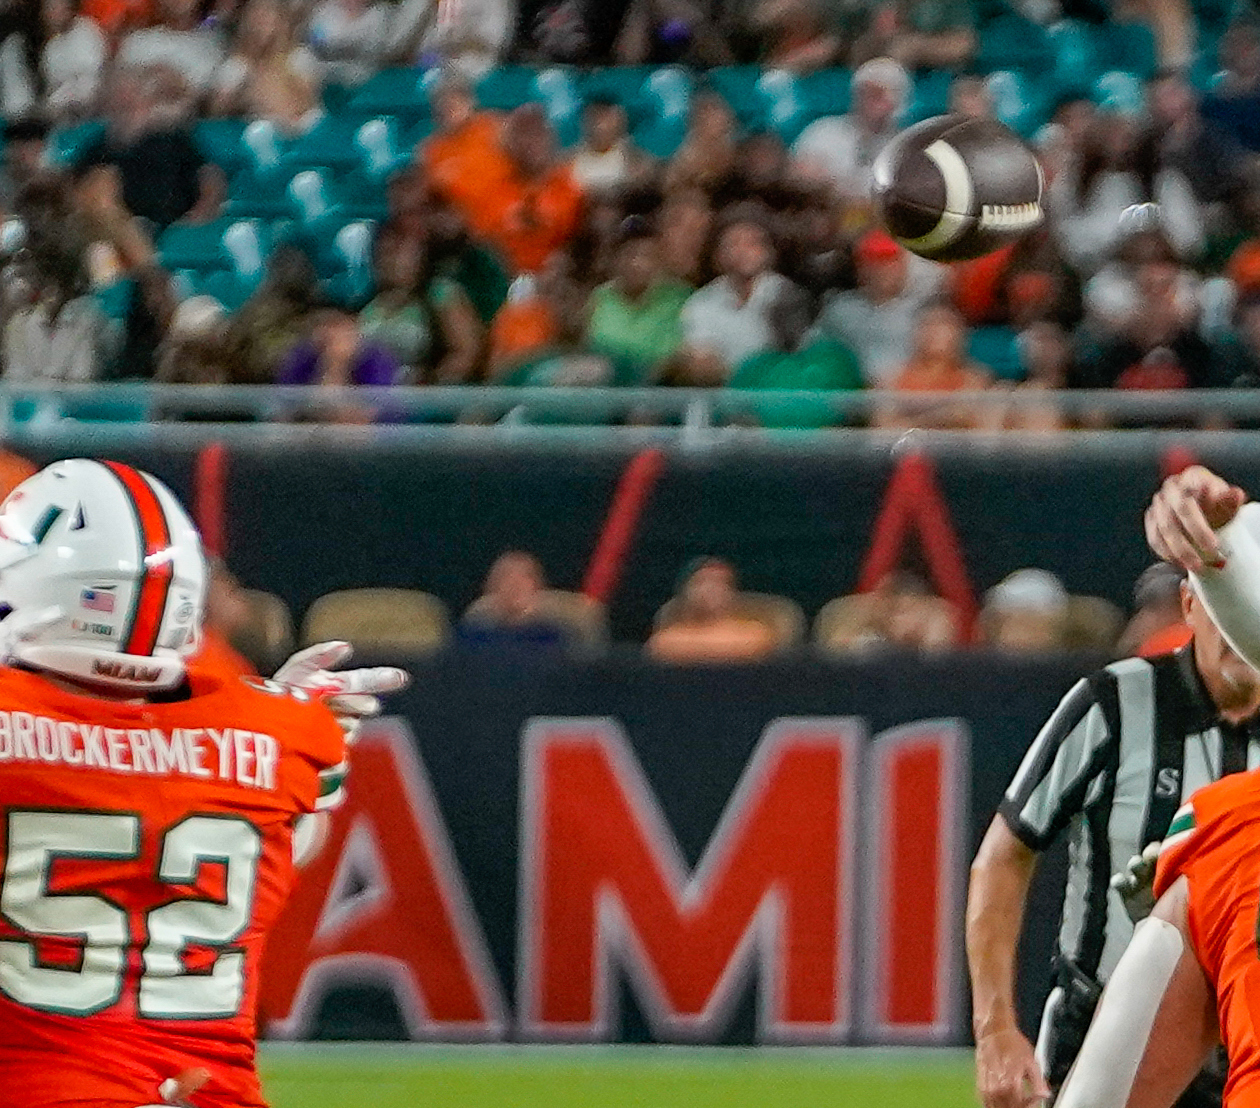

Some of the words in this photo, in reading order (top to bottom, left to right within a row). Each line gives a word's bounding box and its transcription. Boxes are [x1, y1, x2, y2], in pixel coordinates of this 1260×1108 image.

[0, 710, 276, 791] BROCKERMEYER
[1156, 767, 1181, 796] S
[0, 808, 264, 1021] 52
